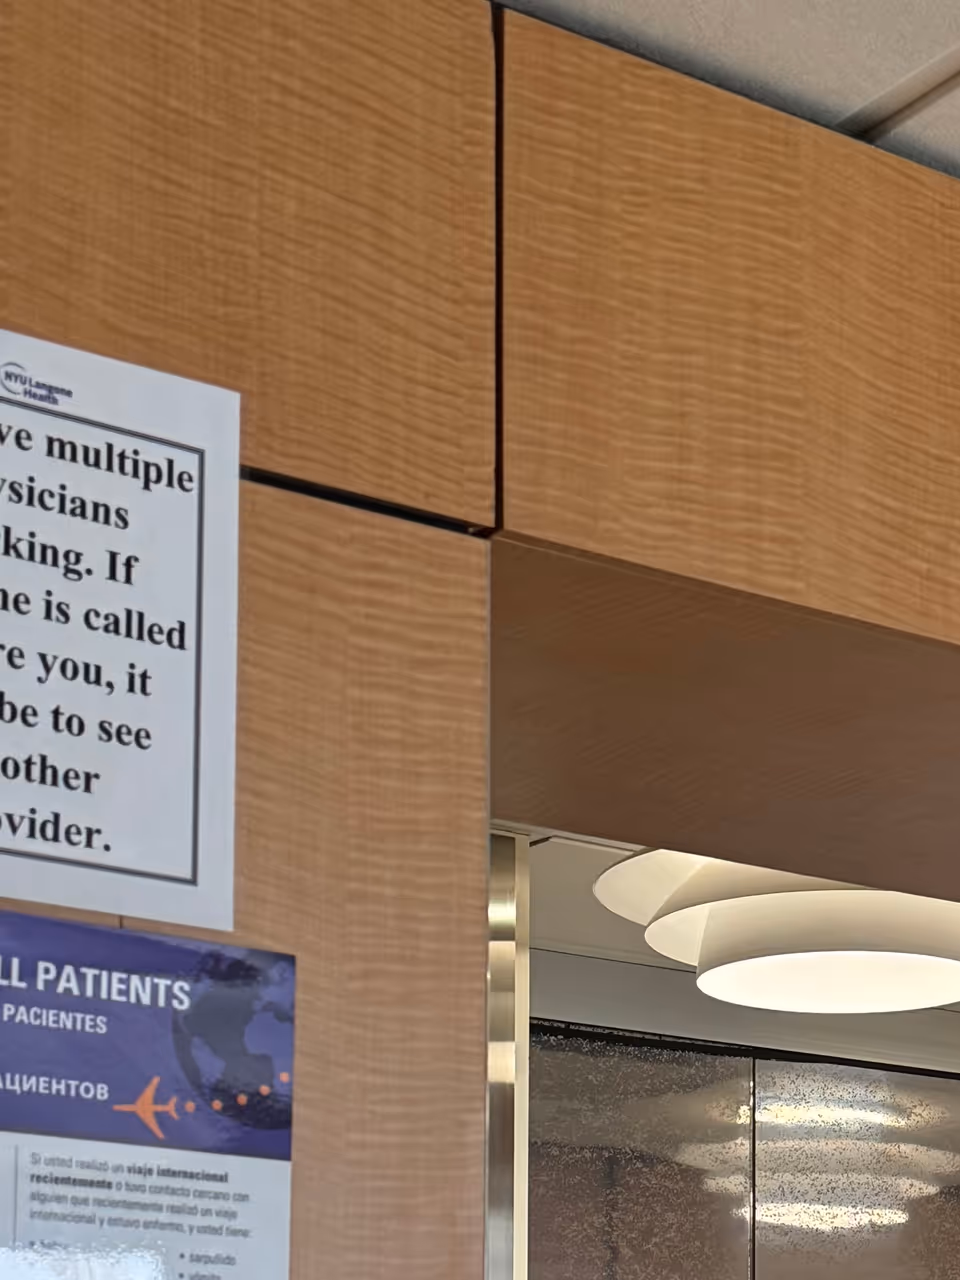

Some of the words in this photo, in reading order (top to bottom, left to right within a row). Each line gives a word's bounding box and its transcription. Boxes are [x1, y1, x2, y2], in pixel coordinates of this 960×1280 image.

[4, 370, 28, 386] NYU
[29, 377, 74, 398] Langone
[23, 386, 59, 405] Health
[45, 433, 195, 492] multiple
[105, 549, 140, 586] If
[42, 589, 71, 625] is
[83, 607, 188, 651] called
[36, 651, 115, 696] you,
[126, 662, 153, 697] it
[50, 704, 86, 737] to
[97, 718, 153, 750] see
[0, 754, 101, 795] other
[0, 807, 111, 852] vider.
[36, 959, 191, 1011] PATIENTS
[2, 1002, 108, 1034] PACIENTES
